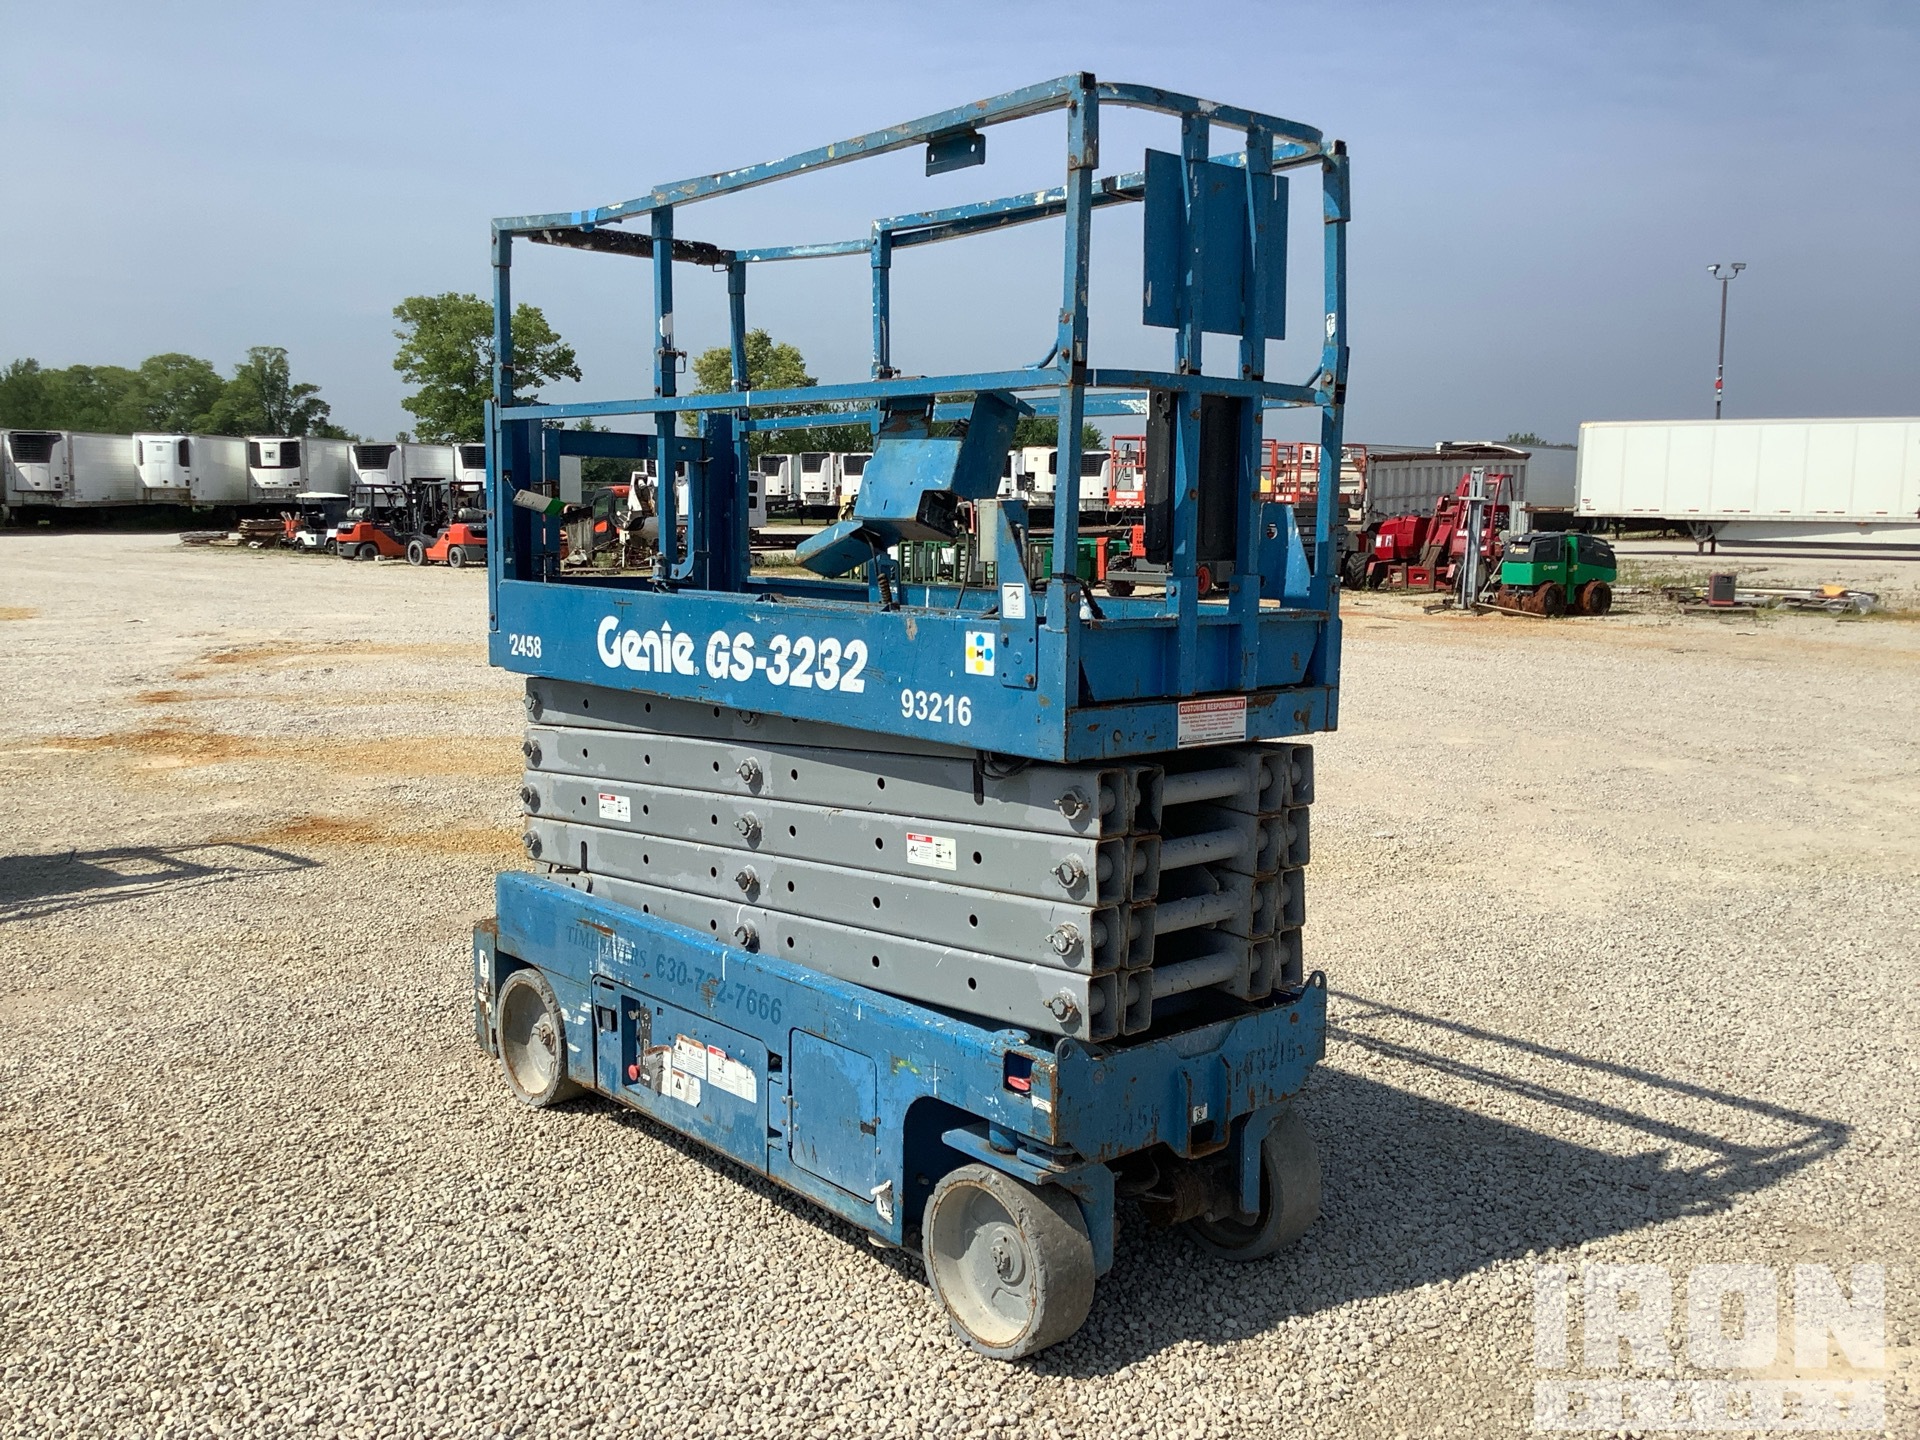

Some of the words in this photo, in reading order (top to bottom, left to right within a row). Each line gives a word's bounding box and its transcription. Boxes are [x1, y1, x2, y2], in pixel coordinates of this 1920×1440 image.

[511, 634, 542, 659] 2458
[597, 615, 695, 676] Genie
[705, 630, 869, 694] GS-3232
[901, 688, 972, 727] 93216
